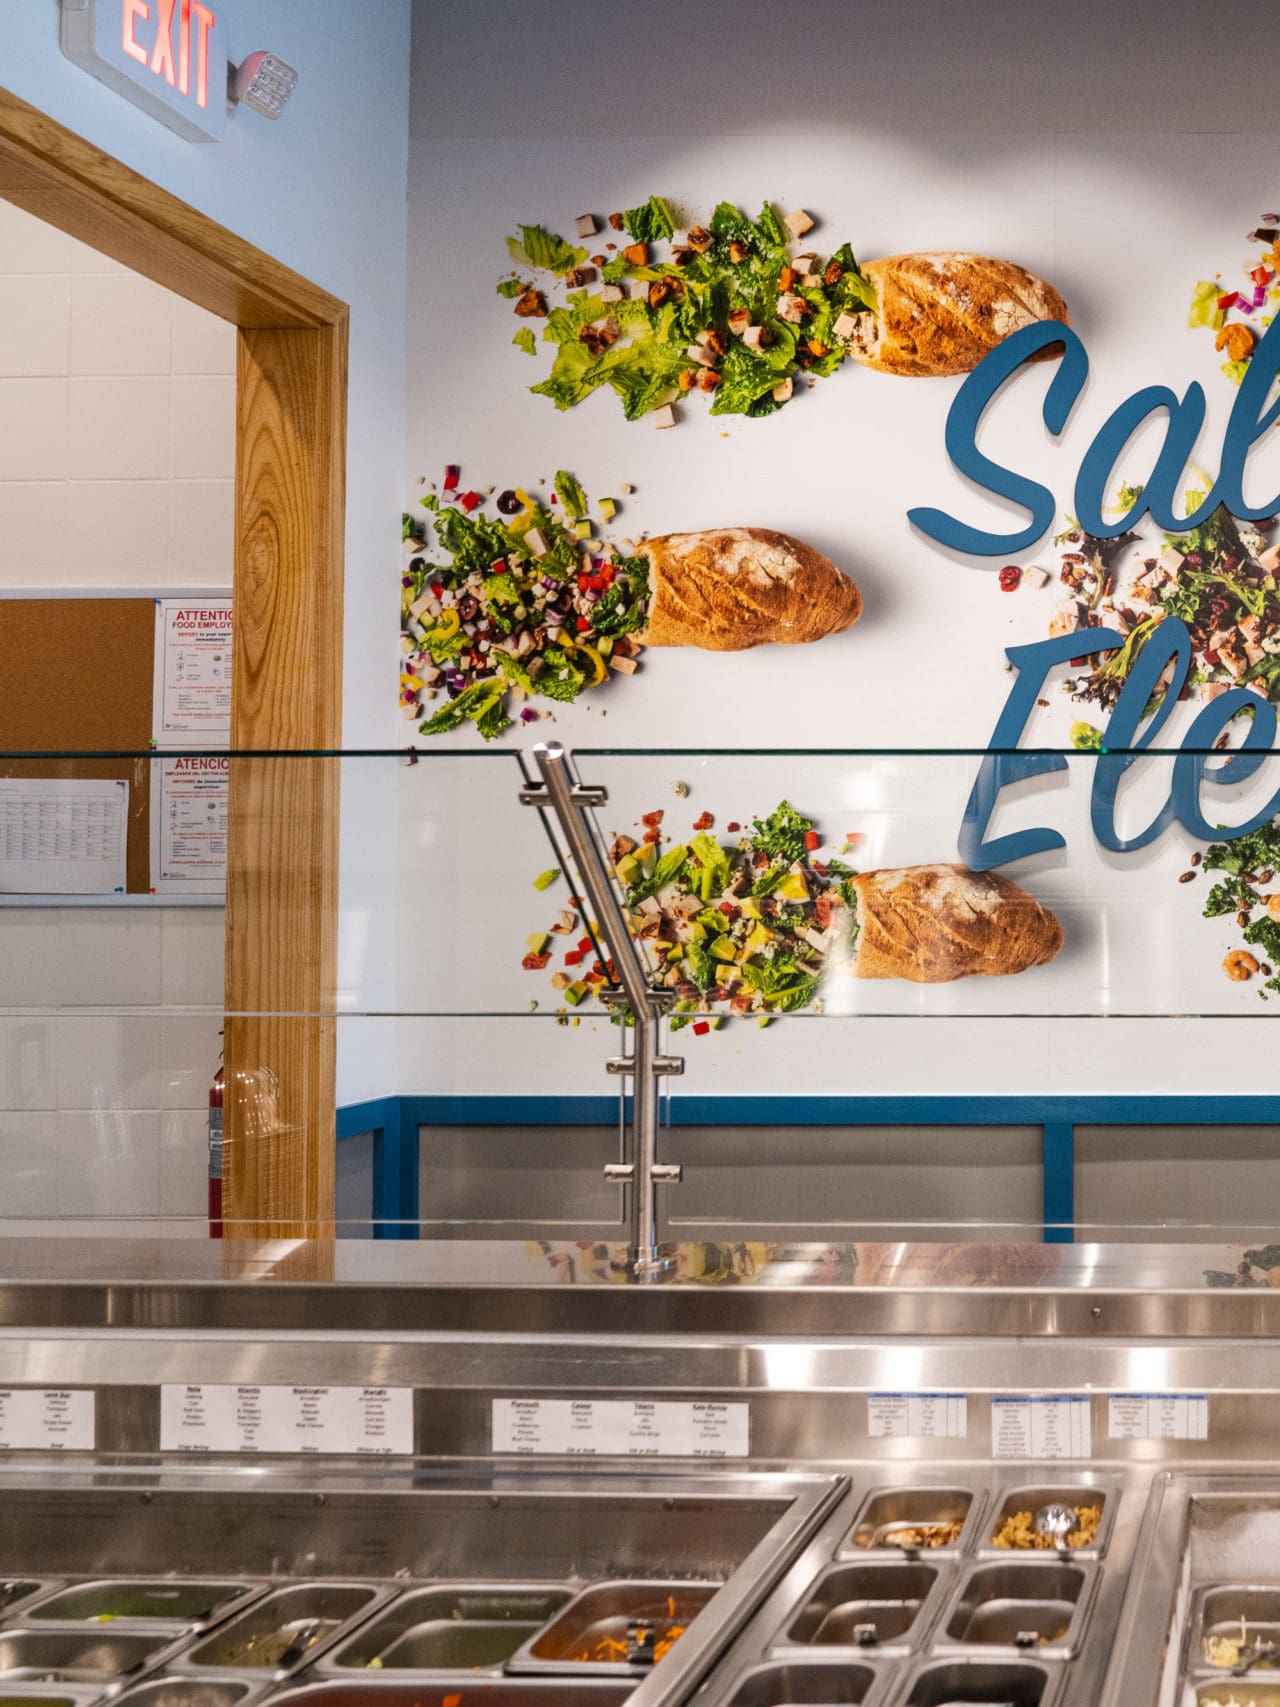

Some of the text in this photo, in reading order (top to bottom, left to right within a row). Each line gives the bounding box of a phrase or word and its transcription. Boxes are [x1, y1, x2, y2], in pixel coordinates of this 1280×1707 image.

[121, 0, 216, 110] EXIT
[176, 610, 233, 621] ATTENTIO
[172, 621, 196, 629] FOOD
[175, 758, 229, 770] ATENCIO
